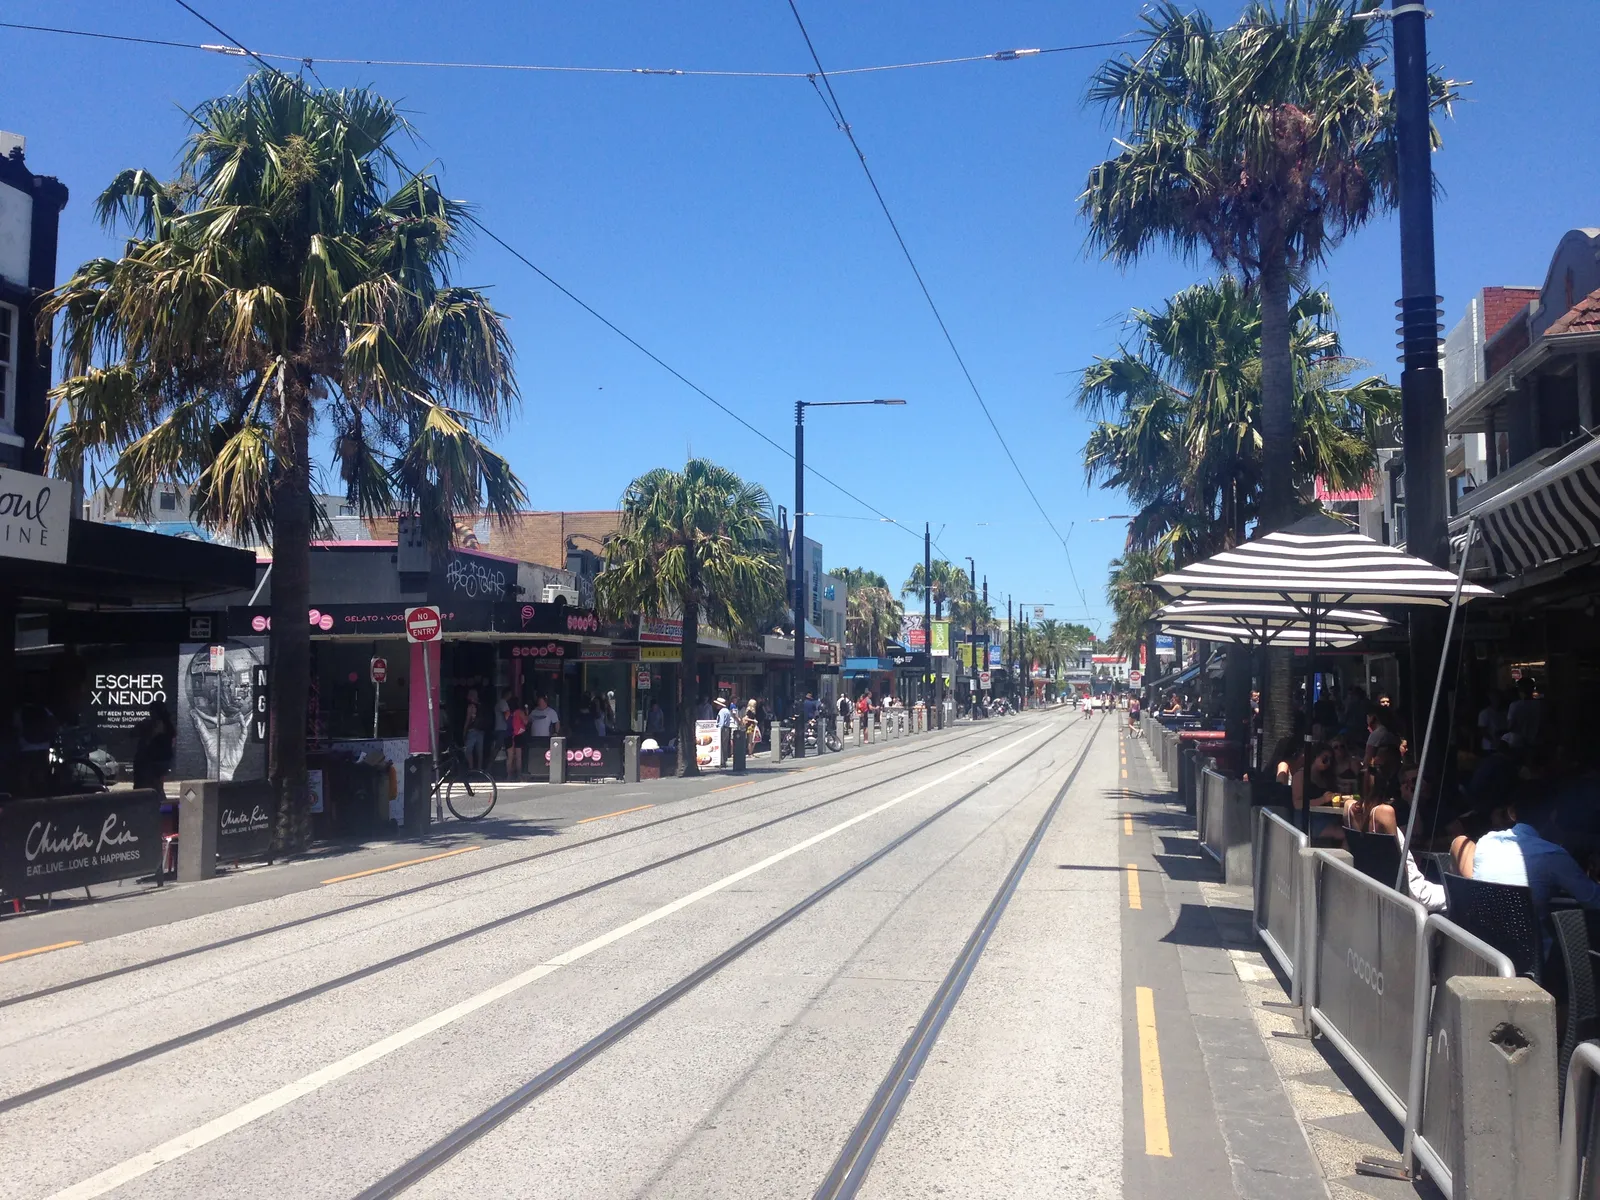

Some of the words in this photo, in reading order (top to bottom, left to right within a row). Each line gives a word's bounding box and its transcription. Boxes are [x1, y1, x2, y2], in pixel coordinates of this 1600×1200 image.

[0, 480, 51, 529] oul
[6, 525, 48, 546] INE
[417, 613, 429, 621] NO
[567, 611, 598, 632] SCOOPS
[413, 628, 437, 638] ENTRY
[512, 643, 565, 656] SCOOPS
[96, 674, 164, 689] ESCHER
[90, 690, 102, 705] X
[108, 690, 167, 705] NENDO
[545, 747, 602, 761] SOOPS
[220, 808, 250, 828] Chinta
[250, 805, 269, 825] Ria
[25, 821, 94, 861] Chinta
[95, 813, 138, 854] Ria
[92, 856, 98, 866] &
[100, 850, 141, 864] HAPPINESS
[1346, 947, 1384, 996] rococo
